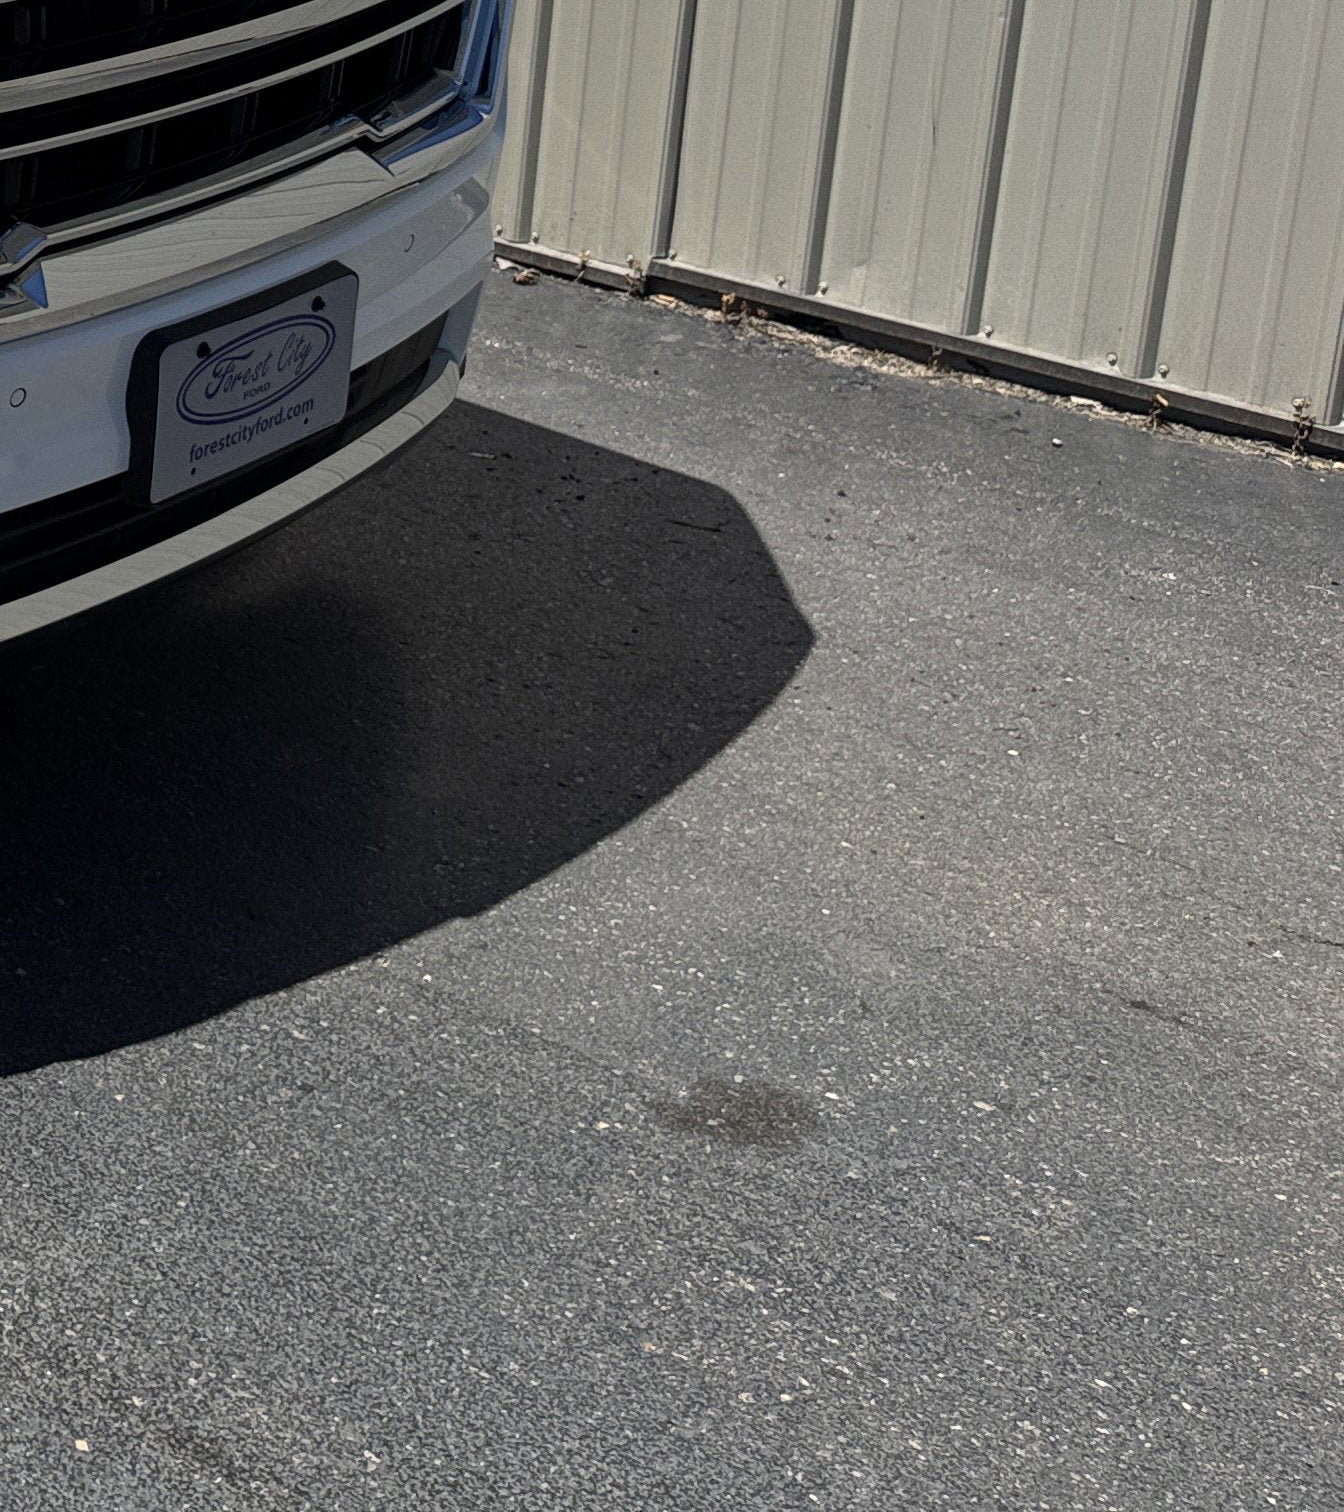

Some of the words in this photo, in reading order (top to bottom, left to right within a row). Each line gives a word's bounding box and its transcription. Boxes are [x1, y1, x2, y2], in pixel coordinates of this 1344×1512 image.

[205, 350, 273, 400] Forest
[277, 332, 312, 376] City
[243, 381, 271, 401] FORD
[189, 398, 314, 463] forestcityford.com
